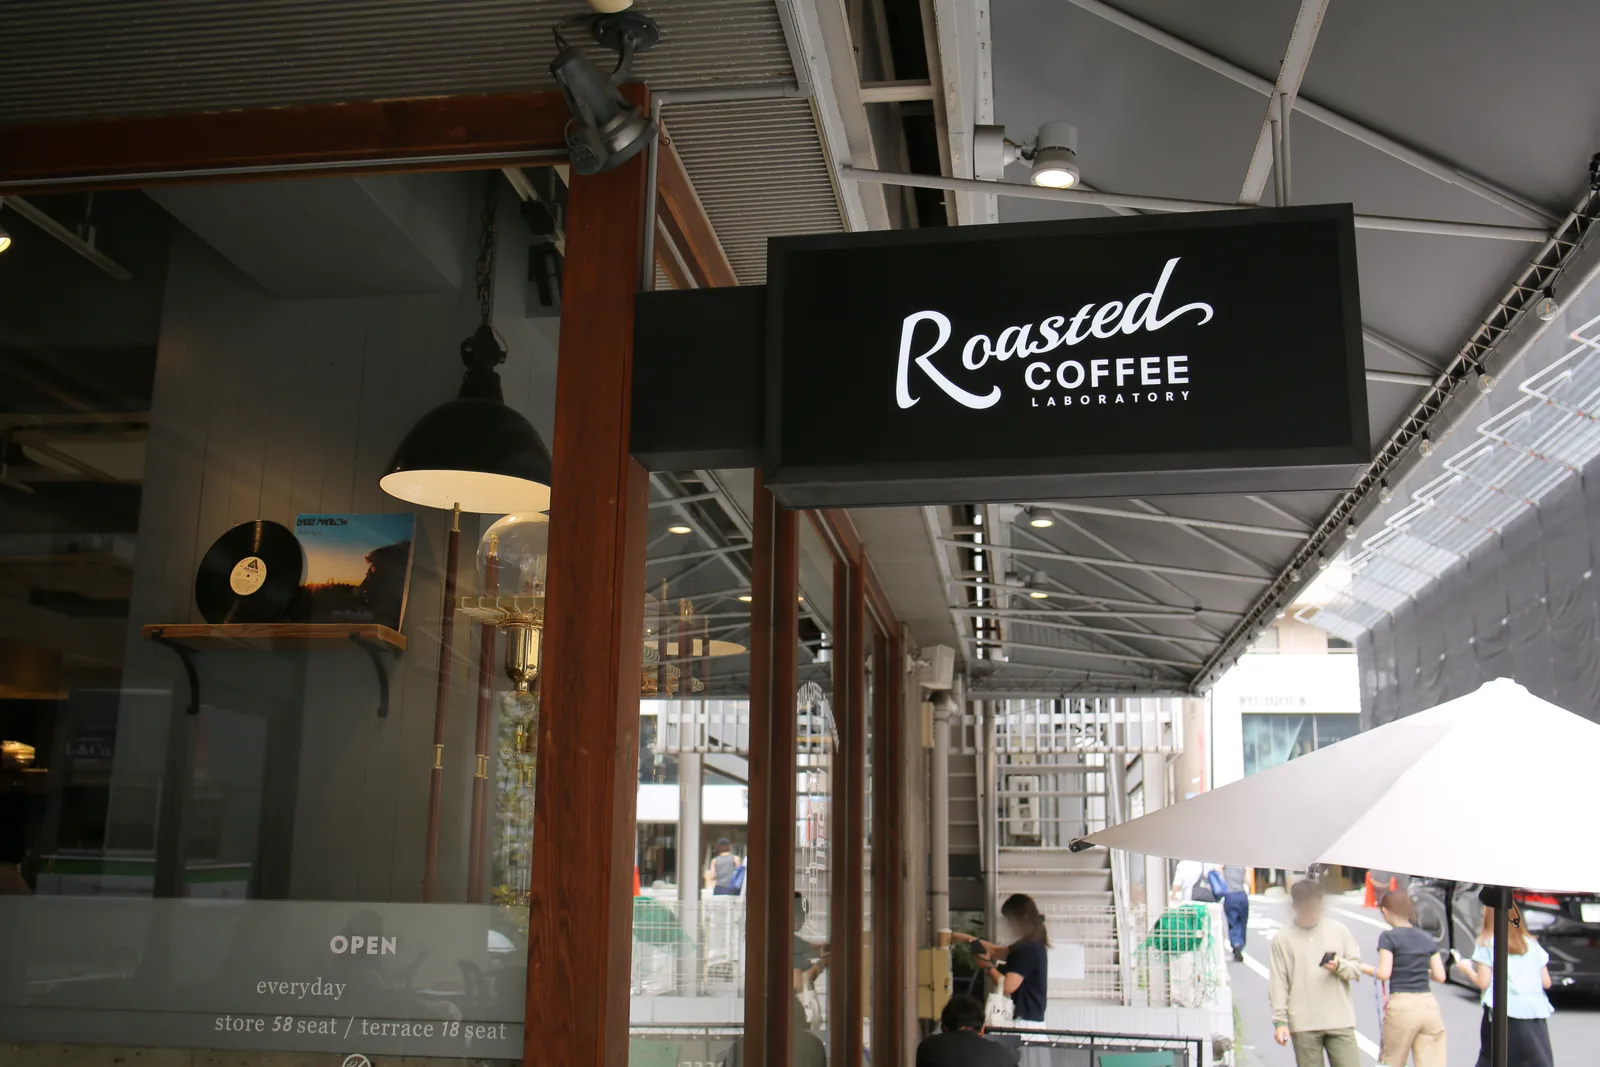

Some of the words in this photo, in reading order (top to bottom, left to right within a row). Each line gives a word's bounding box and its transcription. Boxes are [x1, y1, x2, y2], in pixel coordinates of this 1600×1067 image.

[896, 257, 1214, 410] Roasted
[1024, 355, 1189, 391] COFFEE
[1031, 390, 1191, 408] LABORATORY
[329, 935, 397, 955] OPEN
[256, 976, 347, 1000] everyday
[214, 1015, 265, 1032] store
[271, 1016, 293, 1032] 58
[296, 1018, 337, 1034] seat
[343, 1016, 355, 1039] /
[361, 1019, 434, 1037] terrace
[441, 1021, 460, 1037] 18
[464, 1023, 506, 1039] seat
